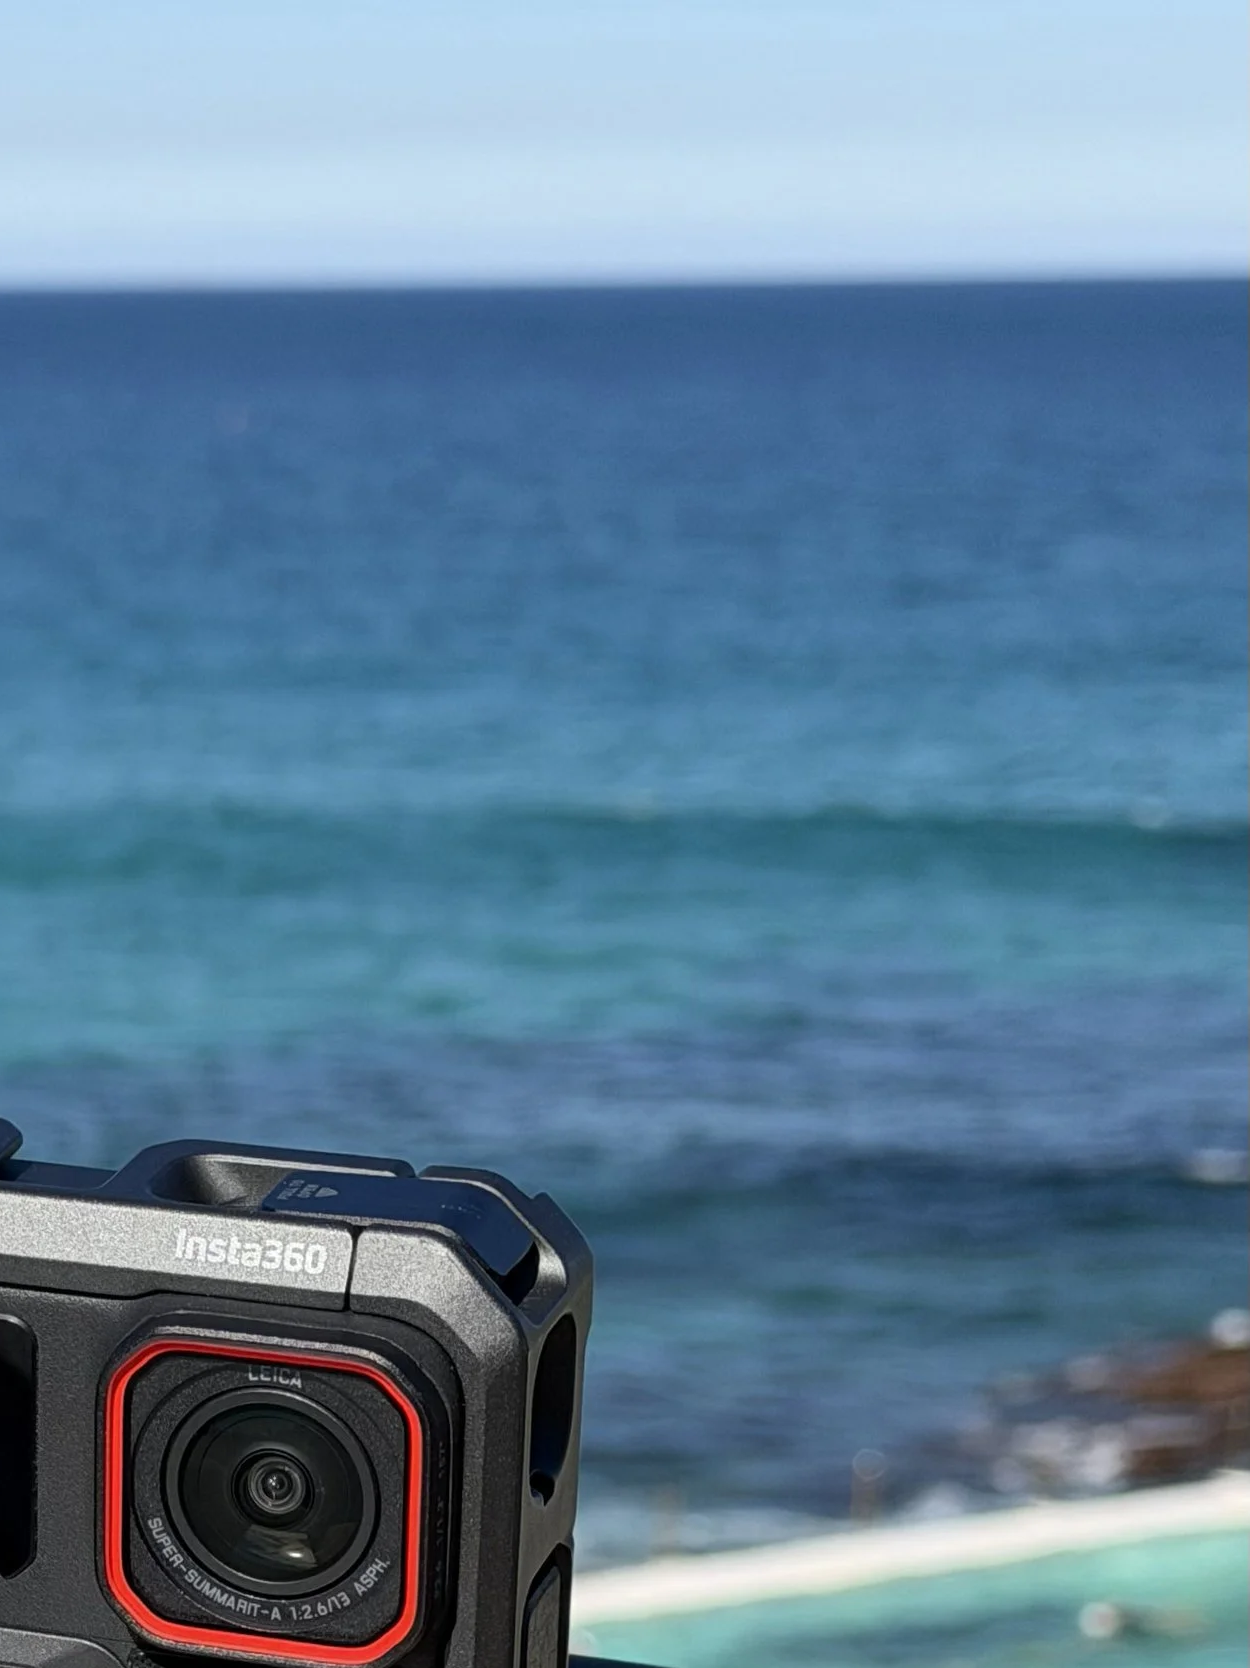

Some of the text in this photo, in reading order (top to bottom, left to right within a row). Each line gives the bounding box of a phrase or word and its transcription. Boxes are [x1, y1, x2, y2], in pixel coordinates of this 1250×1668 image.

[175, 1228, 328, 1275] Insta360
[248, 1365, 302, 1389] LEICA
[147, 1517, 391, 1621] SUPER-SUMMARIT-A 1:2.6/13 ASPH.
